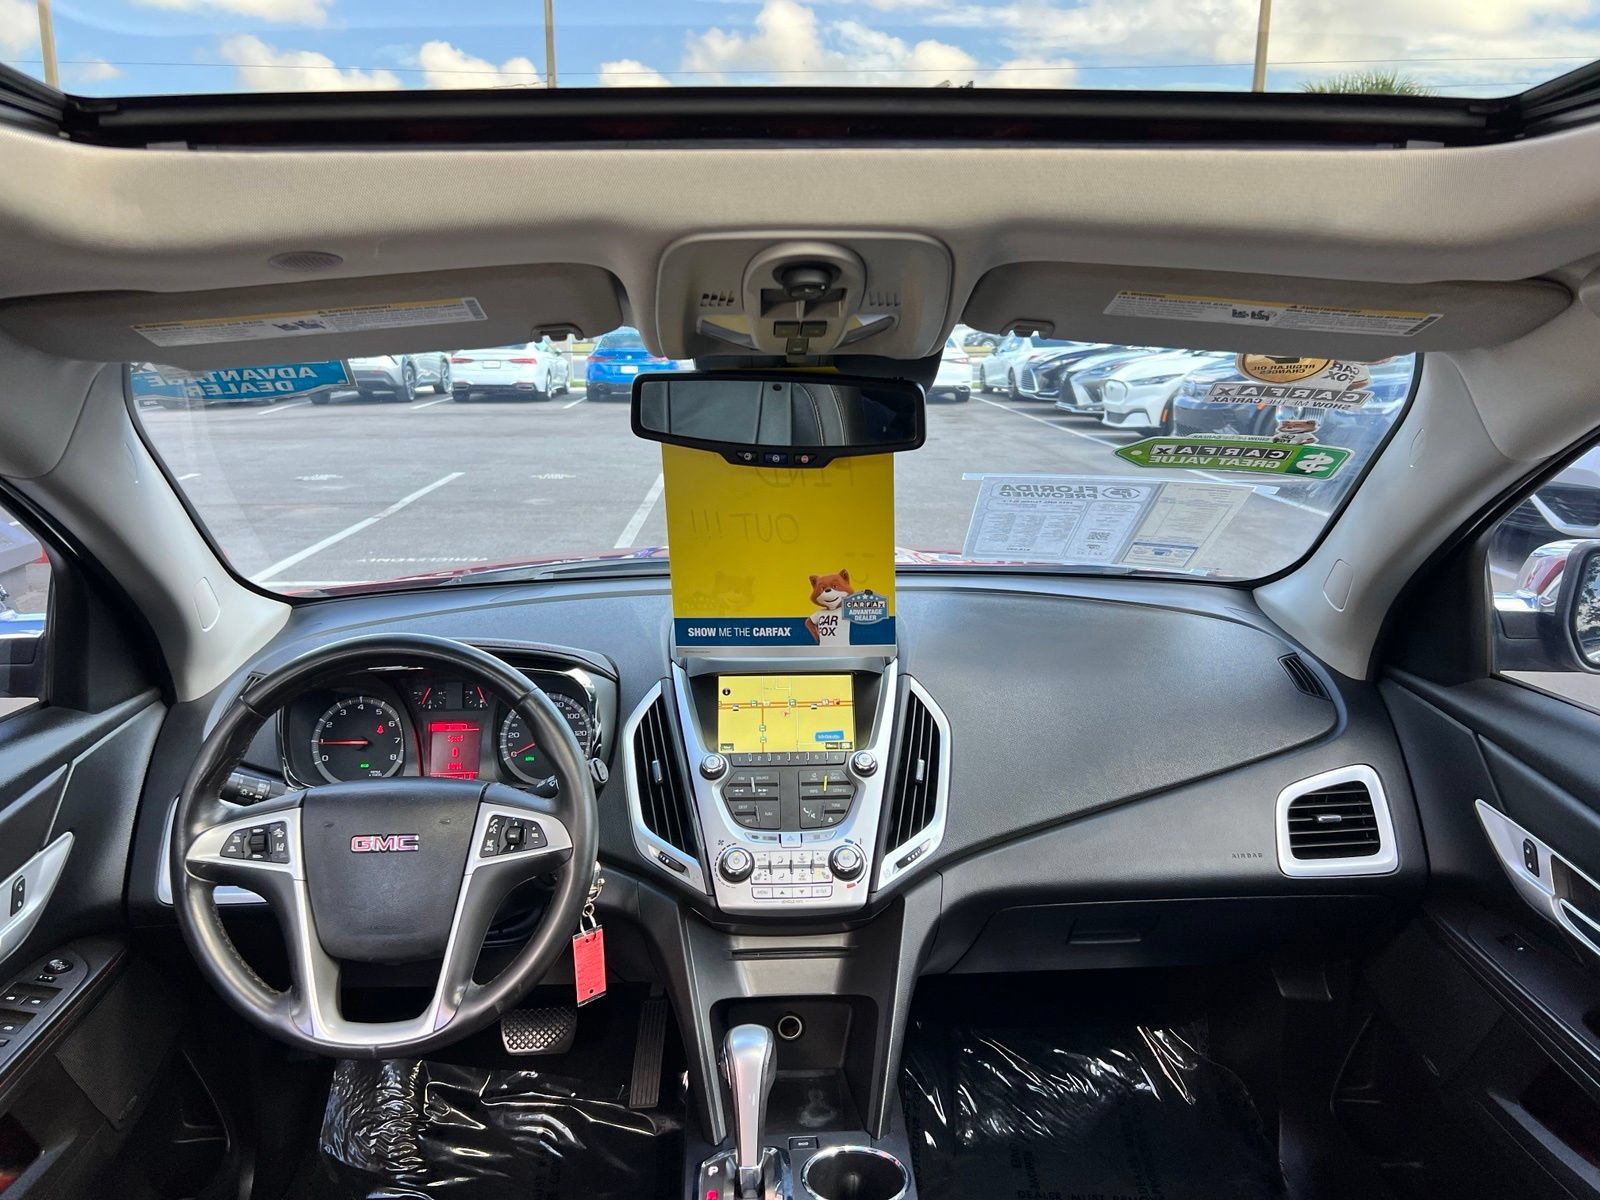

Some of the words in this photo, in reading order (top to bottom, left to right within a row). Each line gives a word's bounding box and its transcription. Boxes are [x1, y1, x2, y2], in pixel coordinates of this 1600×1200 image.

[818, 615, 838, 626] CAR
[688, 627, 716, 637] SHOW
[719, 628, 732, 637] ME
[734, 628, 750, 637] THE
[752, 627, 791, 637] CARFAX
[818, 626, 836, 636] FOX
[452, 746, 460, 758] 0
[351, 835, 420, 852] GMC
[708, 1166, 719, 1176] P
